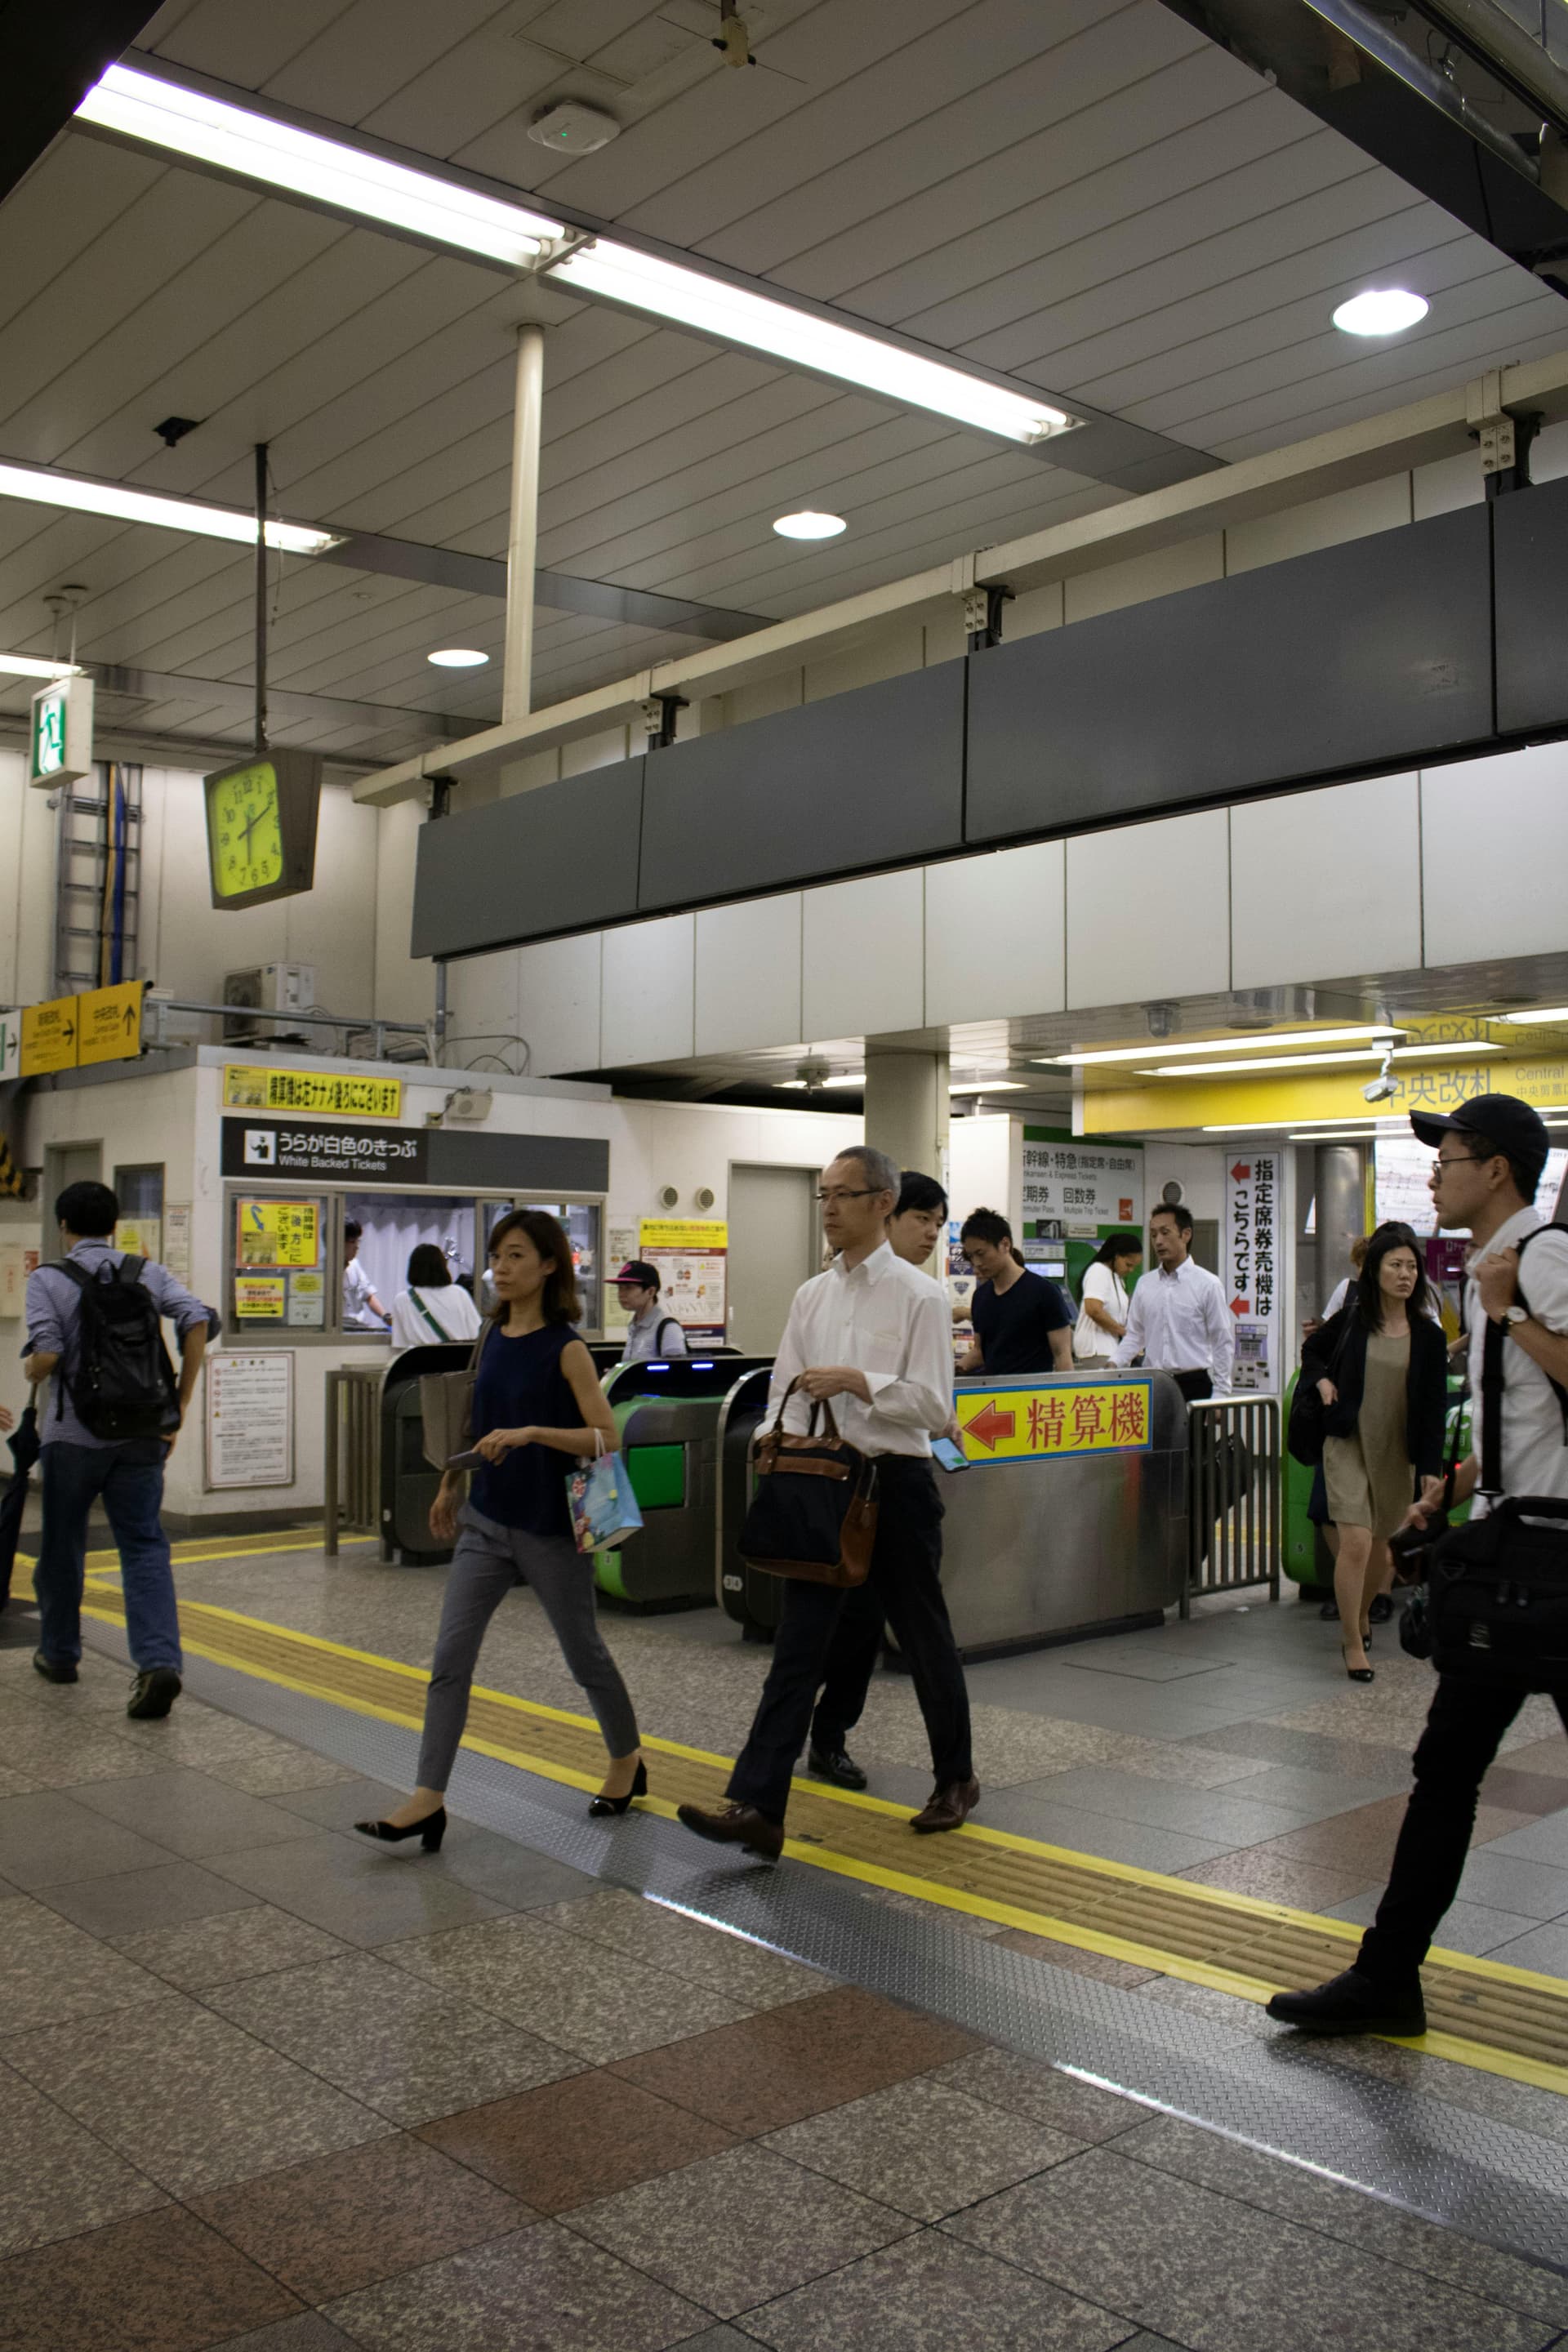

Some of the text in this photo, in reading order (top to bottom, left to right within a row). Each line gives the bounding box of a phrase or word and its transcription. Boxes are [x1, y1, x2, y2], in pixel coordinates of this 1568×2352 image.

[1516, 1065, 1565, 1081] Central
[278, 1132, 417, 1158] うらが白色のきっぷ
[278, 1155, 387, 1171] White Backed Tickets
[1063, 1187, 1096, 1205] 回数券
[1234, 1190, 1250, 1293] こちらです
[1254, 1160, 1274, 1316] 指定席券売機は
[1027, 1392, 1144, 1450] 精算機
